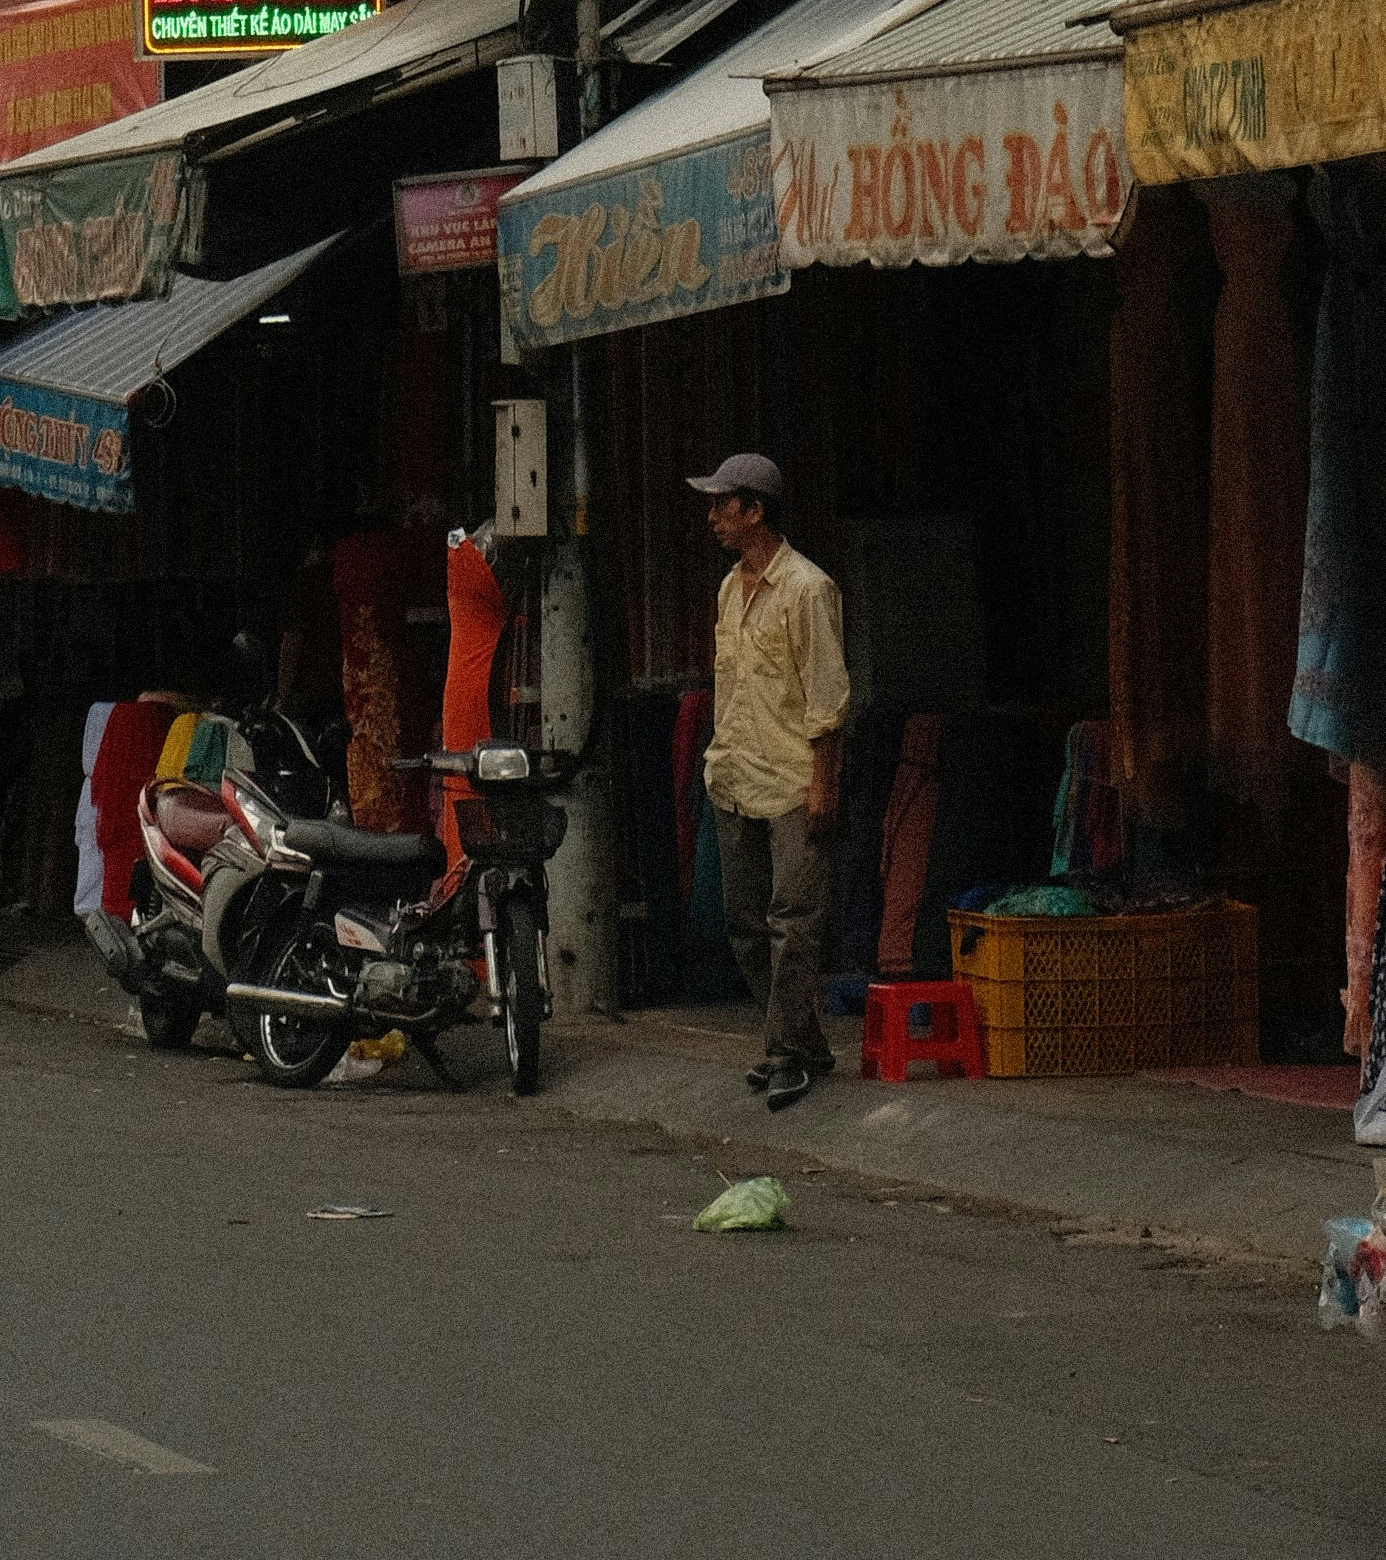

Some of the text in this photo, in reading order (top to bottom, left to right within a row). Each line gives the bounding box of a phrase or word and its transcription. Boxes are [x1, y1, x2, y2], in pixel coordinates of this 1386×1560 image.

[151, 10, 207, 40] CHUYÊN
[209, 5, 248, 38] THIẾT
[250, 4, 269, 36] KẾ
[271, 8, 292, 36] ÁO
[294, 5, 318, 35] DÀI
[319, 11, 349, 34] MAY
[844, 86, 987, 242] HỒNG
[1003, 98, 1120, 235] ĐÀO
[528, 177, 713, 329] Hiền
